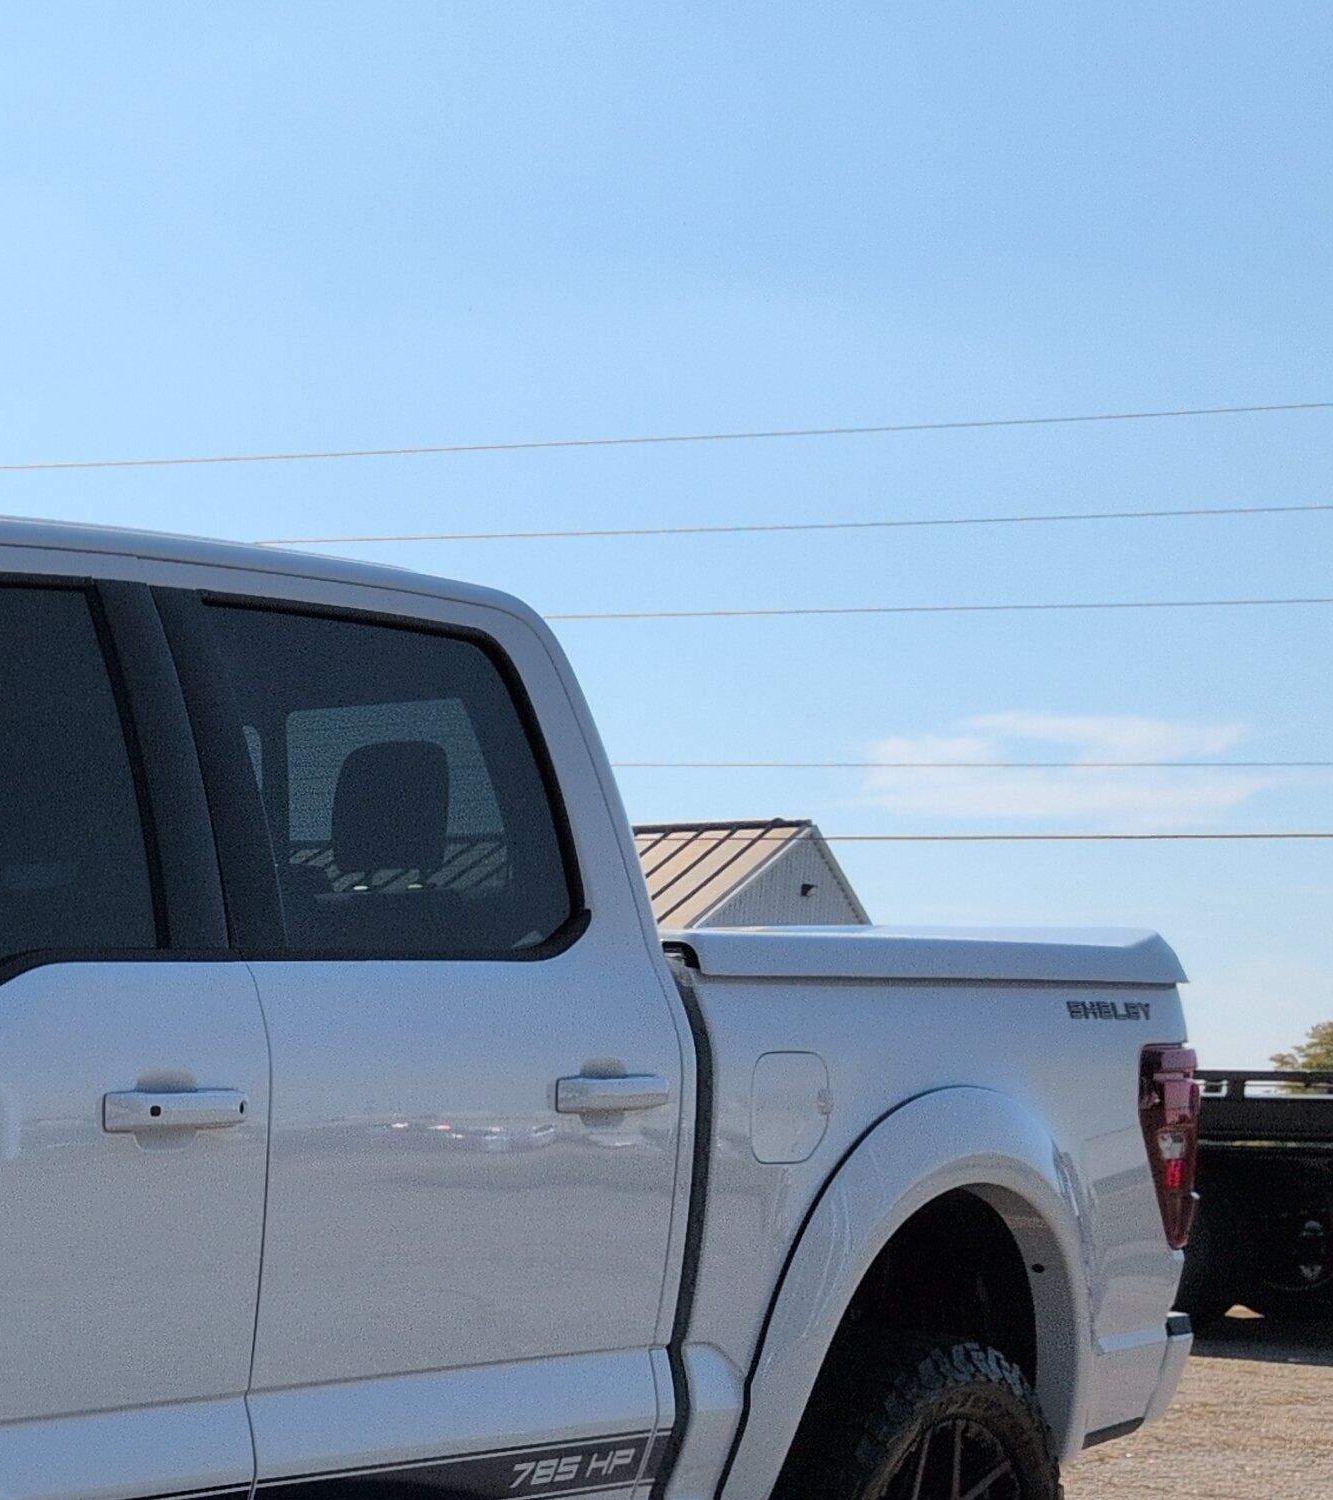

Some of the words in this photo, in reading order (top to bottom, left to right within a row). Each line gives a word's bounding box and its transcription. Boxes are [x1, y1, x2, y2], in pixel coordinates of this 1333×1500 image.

[1066, 1001, 1150, 1020] SHELBY
[509, 1455, 582, 1489] 785
[585, 1448, 635, 1478] HP
